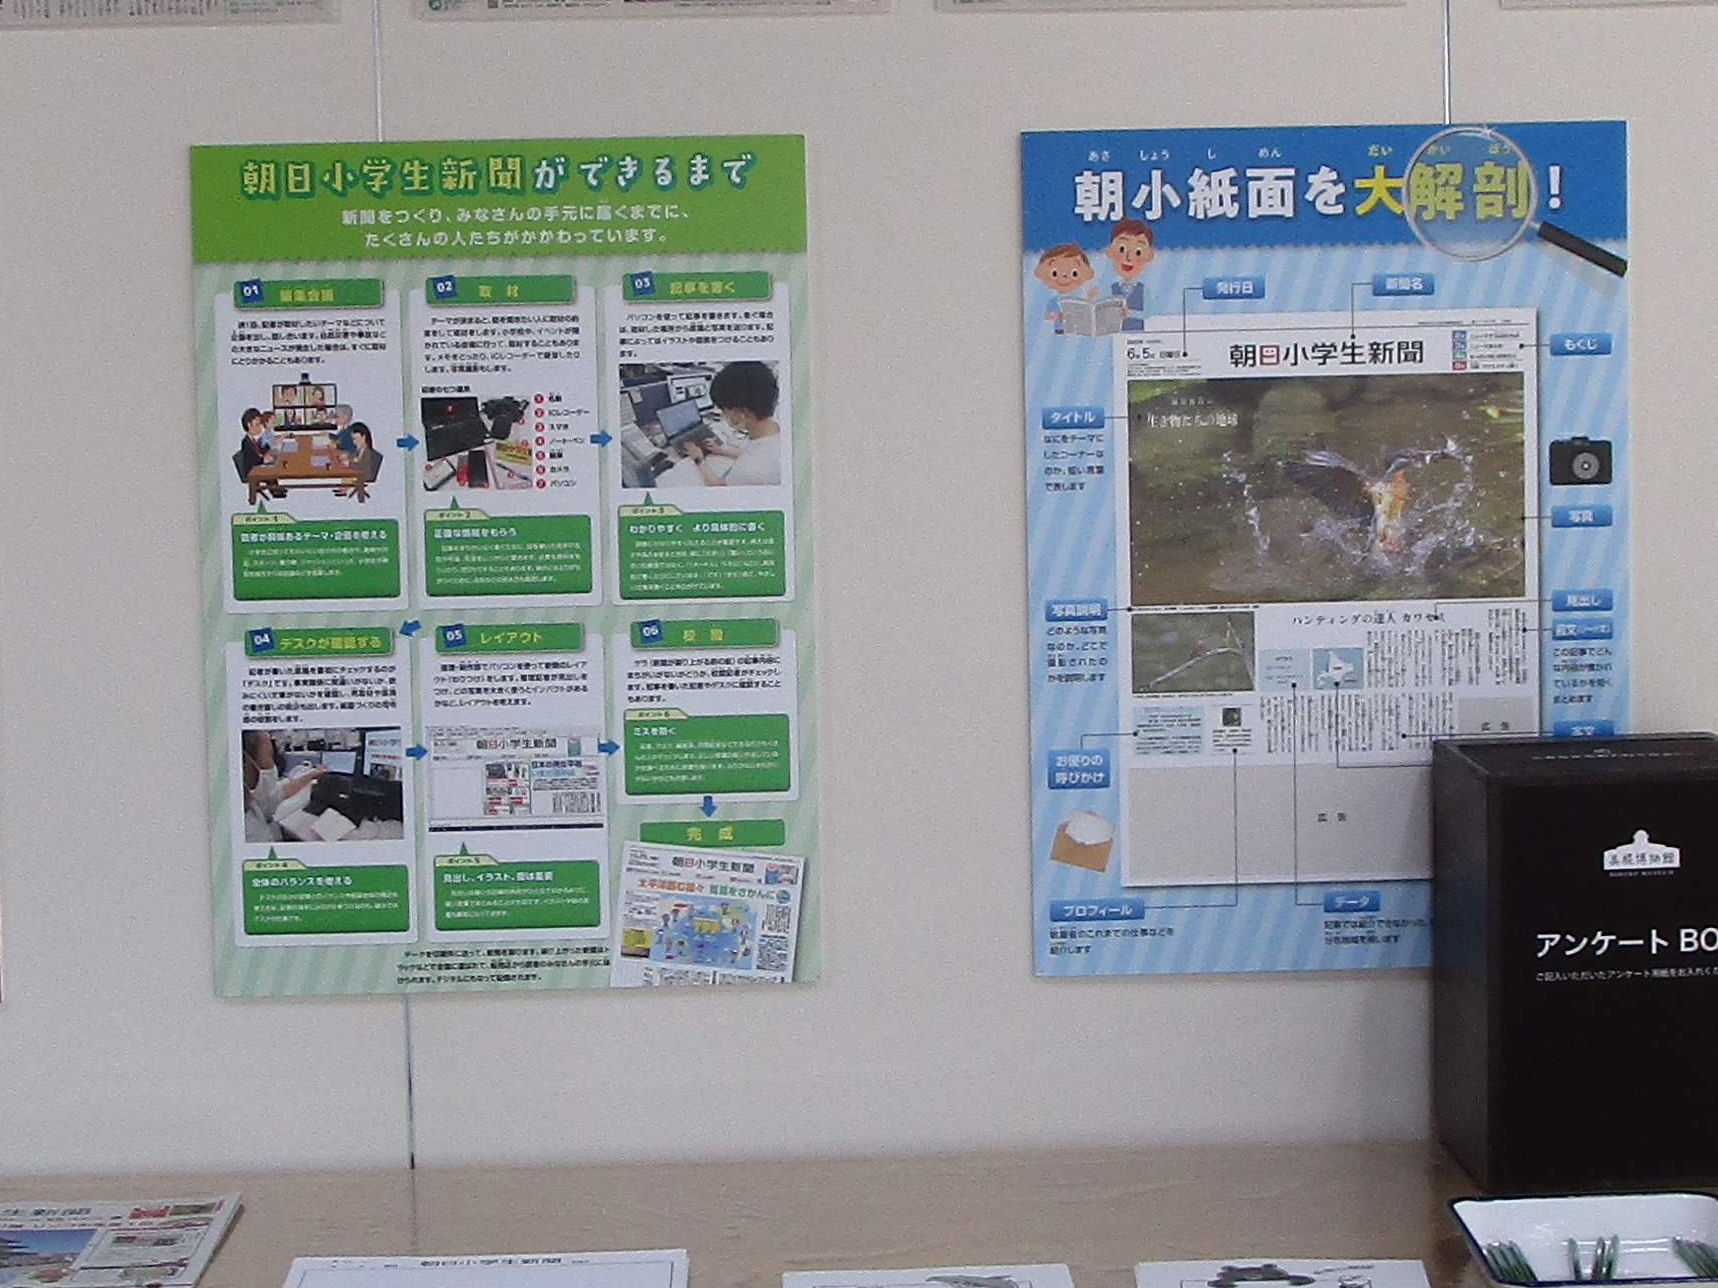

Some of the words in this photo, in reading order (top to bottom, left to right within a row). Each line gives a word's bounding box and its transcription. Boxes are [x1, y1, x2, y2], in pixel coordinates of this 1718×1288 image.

[1258, 146, 1281, 159] めん
[243, 154, 753, 196] 朝日小学生新聞ができるまで
[1073, 162, 1561, 221] 朝小紙面を大解剖！
[341, 203, 690, 226] 新聞をつくり、みなさんの手元に届くまでに、
[364, 227, 668, 248] たくさんの人たちがかかわっています。
[243, 284, 259, 297] 01
[436, 281, 453, 293] 02
[634, 277, 651, 289] 03
[670, 280, 736, 295] 記事を書く
[1215, 278, 1254, 296] 発行日
[1564, 338, 1598, 351] もくじ
[1229, 340, 1424, 368] 朝日小学生新聞
[1050, 411, 1096, 424] タイトル
[1146, 412, 1239, 429] 生き物たちの地球
[629, 523, 683, 534] わかりやすく
[1567, 595, 1601, 607] 見出し
[446, 630, 463, 642] 05
[480, 631, 543, 644] レイアウト
[642, 625, 659, 637] 06
[253, 633, 270, 646] 04
[1055, 754, 1103, 767] お便りの
[686, 825, 735, 842] 完成
[672, 856, 755, 873] 朝日小学生新聞
[1335, 895, 1370, 909] データ
[1063, 904, 1133, 918] プロフィール
[1536, 928, 1669, 958] アンケート
